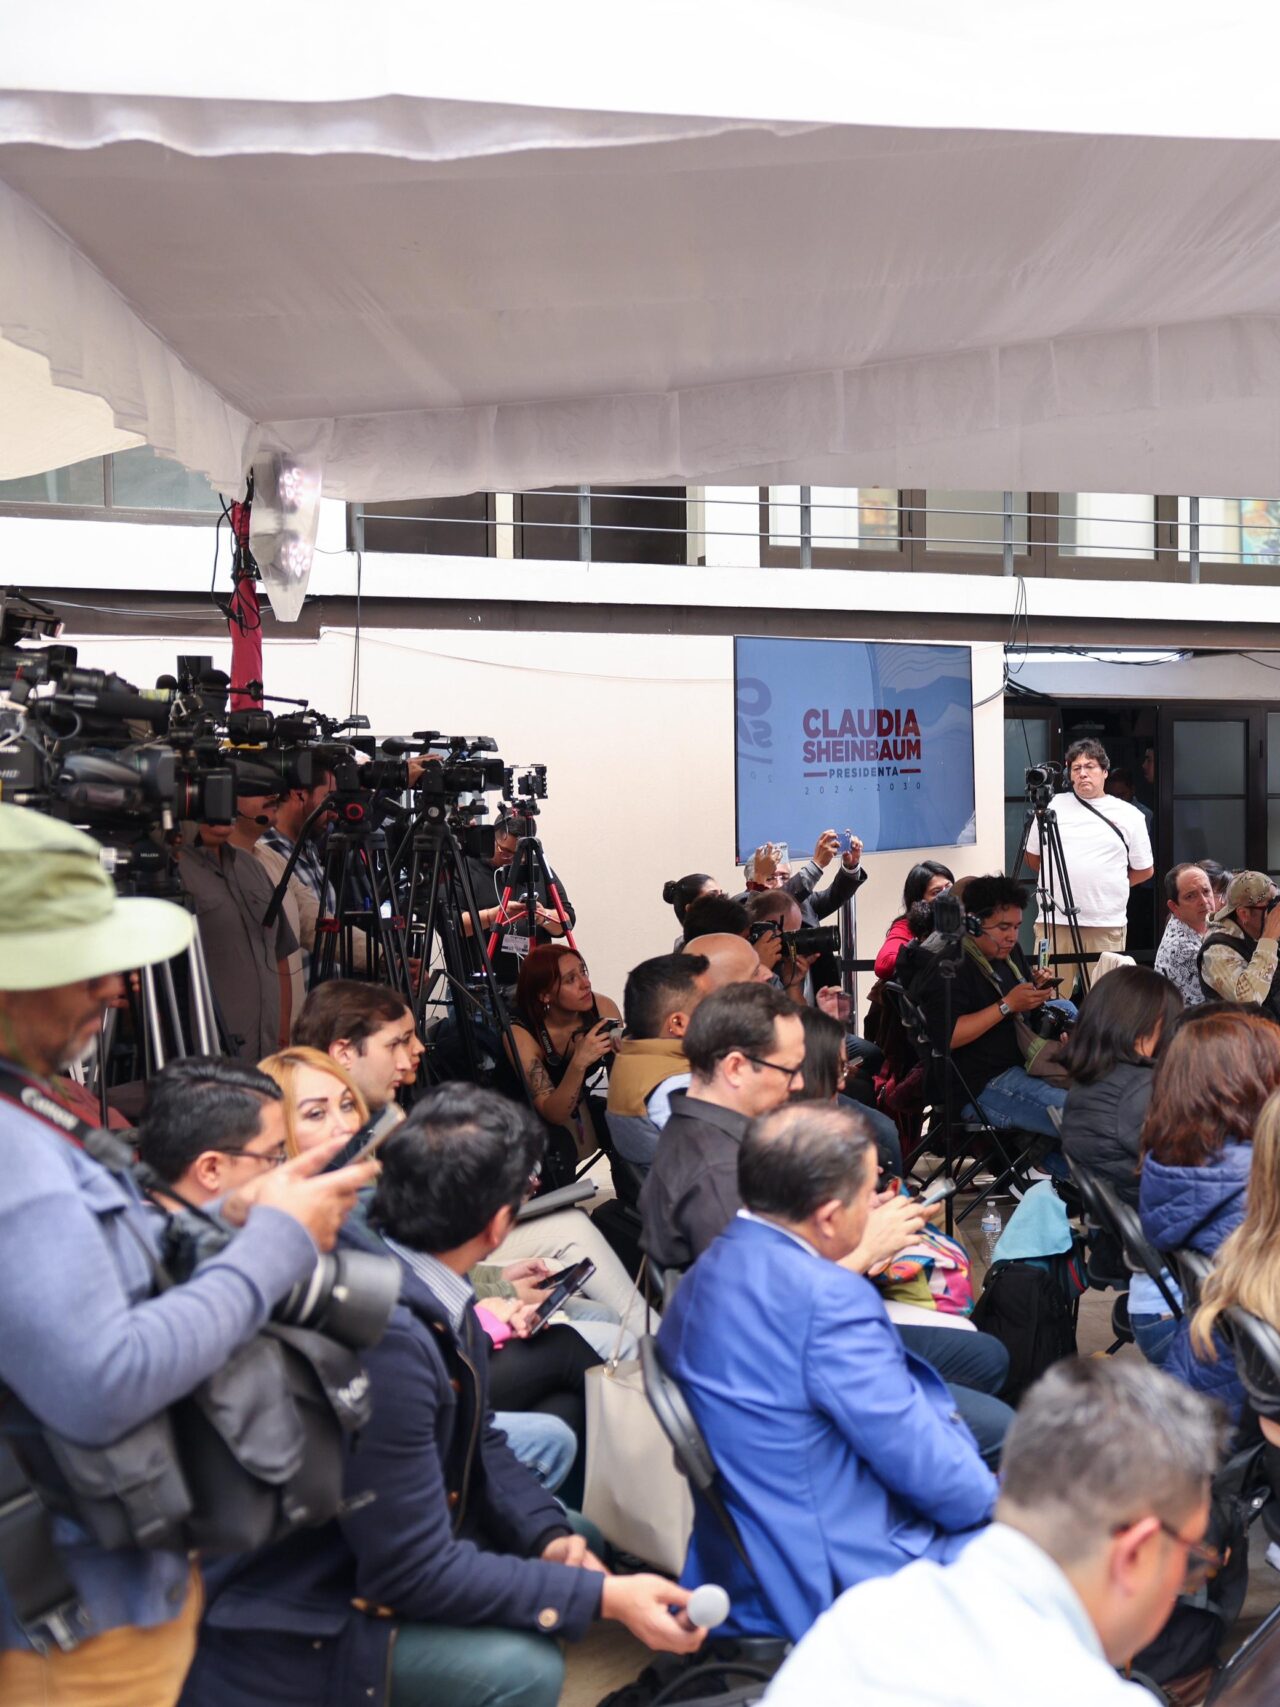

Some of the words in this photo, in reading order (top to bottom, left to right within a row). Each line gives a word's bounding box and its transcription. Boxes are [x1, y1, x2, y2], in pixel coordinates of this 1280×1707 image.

[802, 708, 921, 739] CLAUDIA
[802, 739, 922, 764] SHEINBAUM
[829, 766, 899, 779] PRESIDENTA
[21, 1087, 79, 1130] Canon
